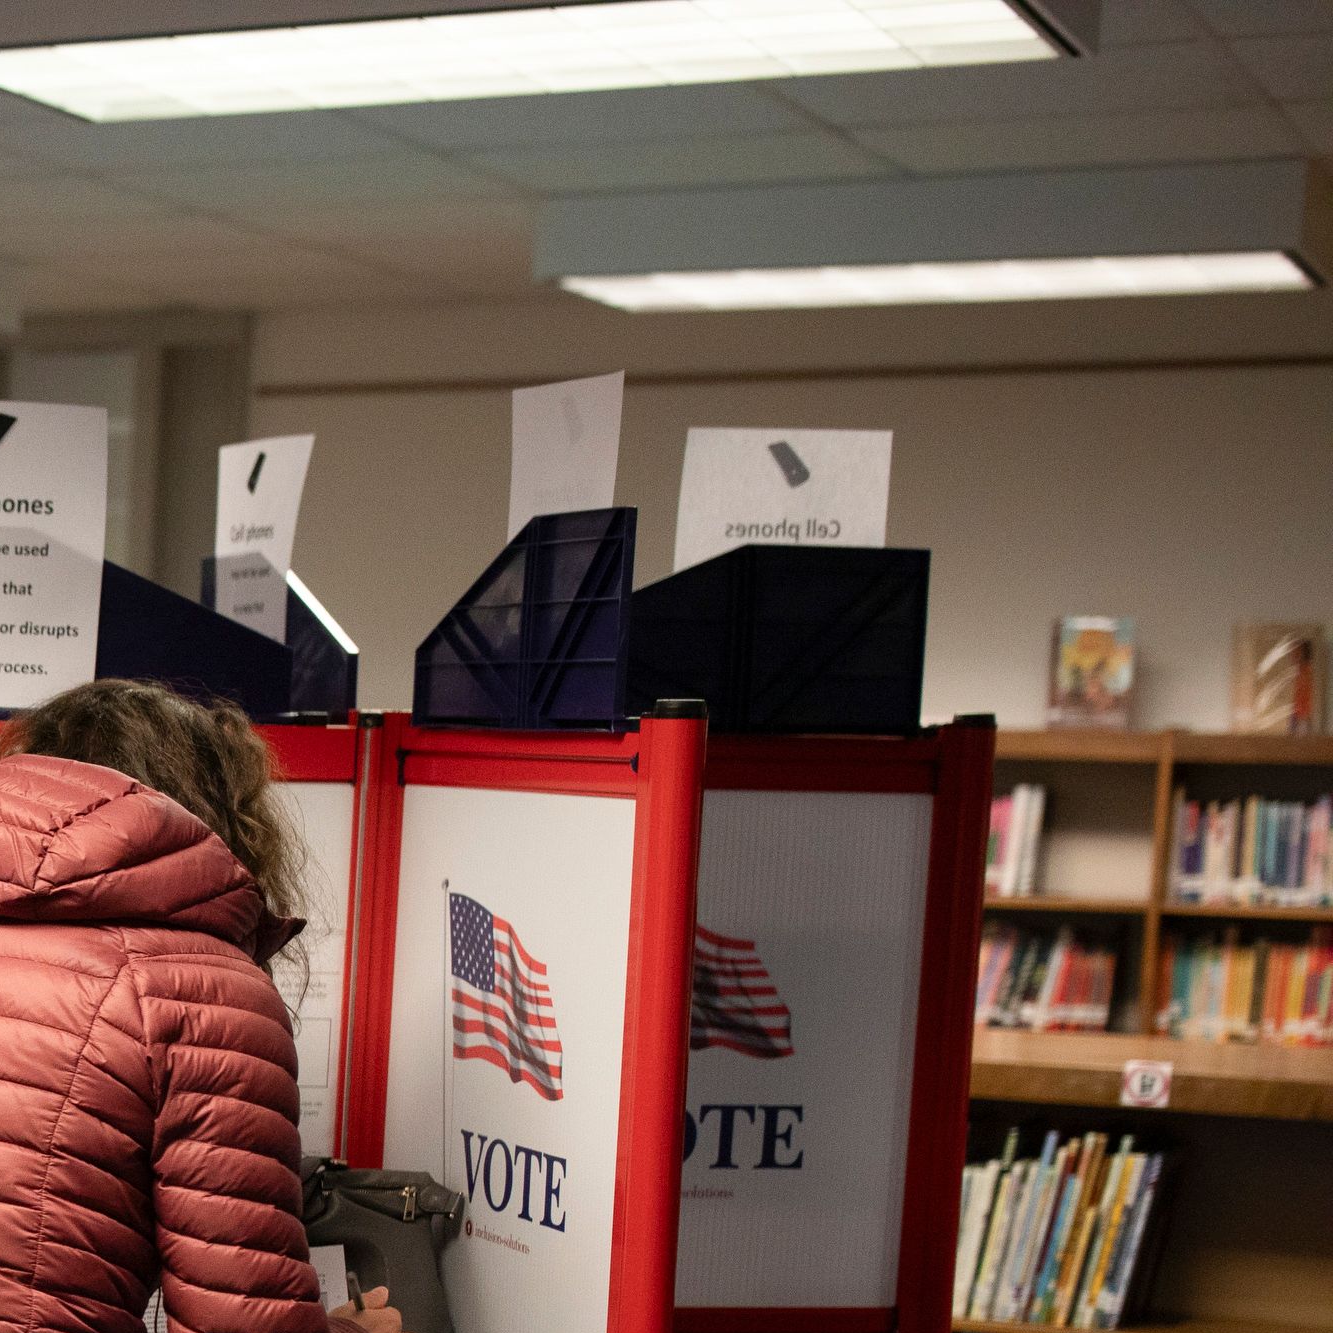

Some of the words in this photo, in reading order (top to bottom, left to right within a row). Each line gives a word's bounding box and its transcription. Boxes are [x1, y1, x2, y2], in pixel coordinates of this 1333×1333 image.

[14, 542, 50, 557] used
[2, 581, 33, 596] that
[0, 622, 16, 634] or
[19, 621, 79, 639] disrupts
[684, 1104, 803, 1169] TE
[461, 1128, 567, 1233] VOTE
